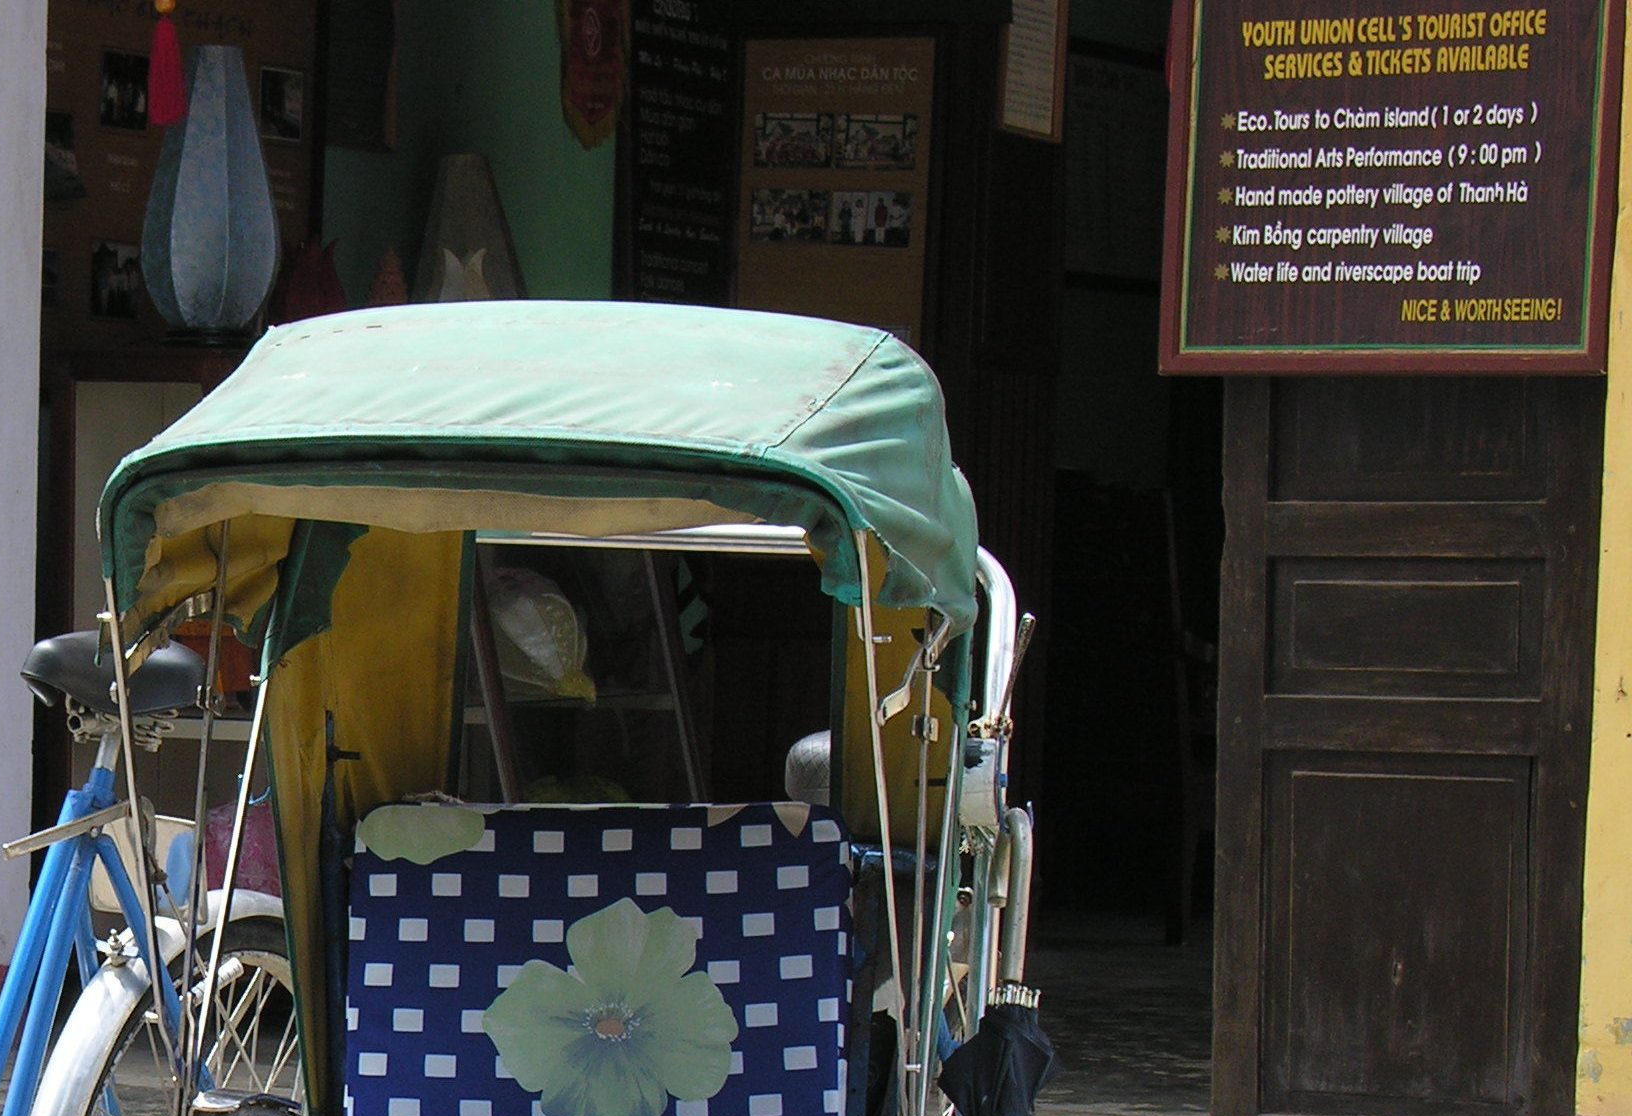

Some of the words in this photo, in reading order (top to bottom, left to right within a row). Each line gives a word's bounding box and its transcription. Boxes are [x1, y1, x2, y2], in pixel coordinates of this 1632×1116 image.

[1242, 20, 1295, 47] YOUTH
[1300, 18, 1354, 45] UNION
[1357, 16, 1396, 43] CELL
[1417, 12, 1486, 40] TOURIST
[1489, 9, 1547, 37] OFFICE
[1264, 51, 1343, 80] SERVICES
[1348, 51, 1363, 76] &
[1366, 48, 1431, 75] TICKETS
[1436, 43, 1529, 73] AVAILABLE
[762, 67, 782, 81] CA
[819, 67, 856, 83] NHẠC
[1315, 108, 1331, 129] to
[1334, 107, 1380, 129] Chàm
[1453, 108, 1470, 126] or
[1472, 104, 1483, 125] 2
[1236, 148, 1312, 170] Traditional
[1315, 147, 1344, 169] Arts
[1346, 146, 1443, 168] Performance
[1501, 146, 1527, 169] pm
[1235, 186, 1275, 207] Hand
[1278, 185, 1322, 206] made
[1326, 185, 1379, 210] pottery
[1383, 183, 1433, 209] village
[1437, 182, 1453, 203] of
[1459, 182, 1504, 203] Thanh
[1506, 180, 1528, 203] Hà
[1233, 225, 1260, 245] Kim
[1307, 224, 1379, 249] carpentry
[1383, 224, 1433, 249] village
[1231, 262, 1274, 283] Water
[1276, 261, 1299, 282] life
[1302, 261, 1332, 282] and
[1335, 261, 1414, 284] riverscape
[1417, 261, 1453, 281] boat
[1456, 260, 1481, 285] trip
[1401, 299, 1437, 322] NICE
[1440, 299, 1451, 321] &
[1454, 299, 1502, 321] WORTH
[1503, 298, 1563, 321] SEEING!
